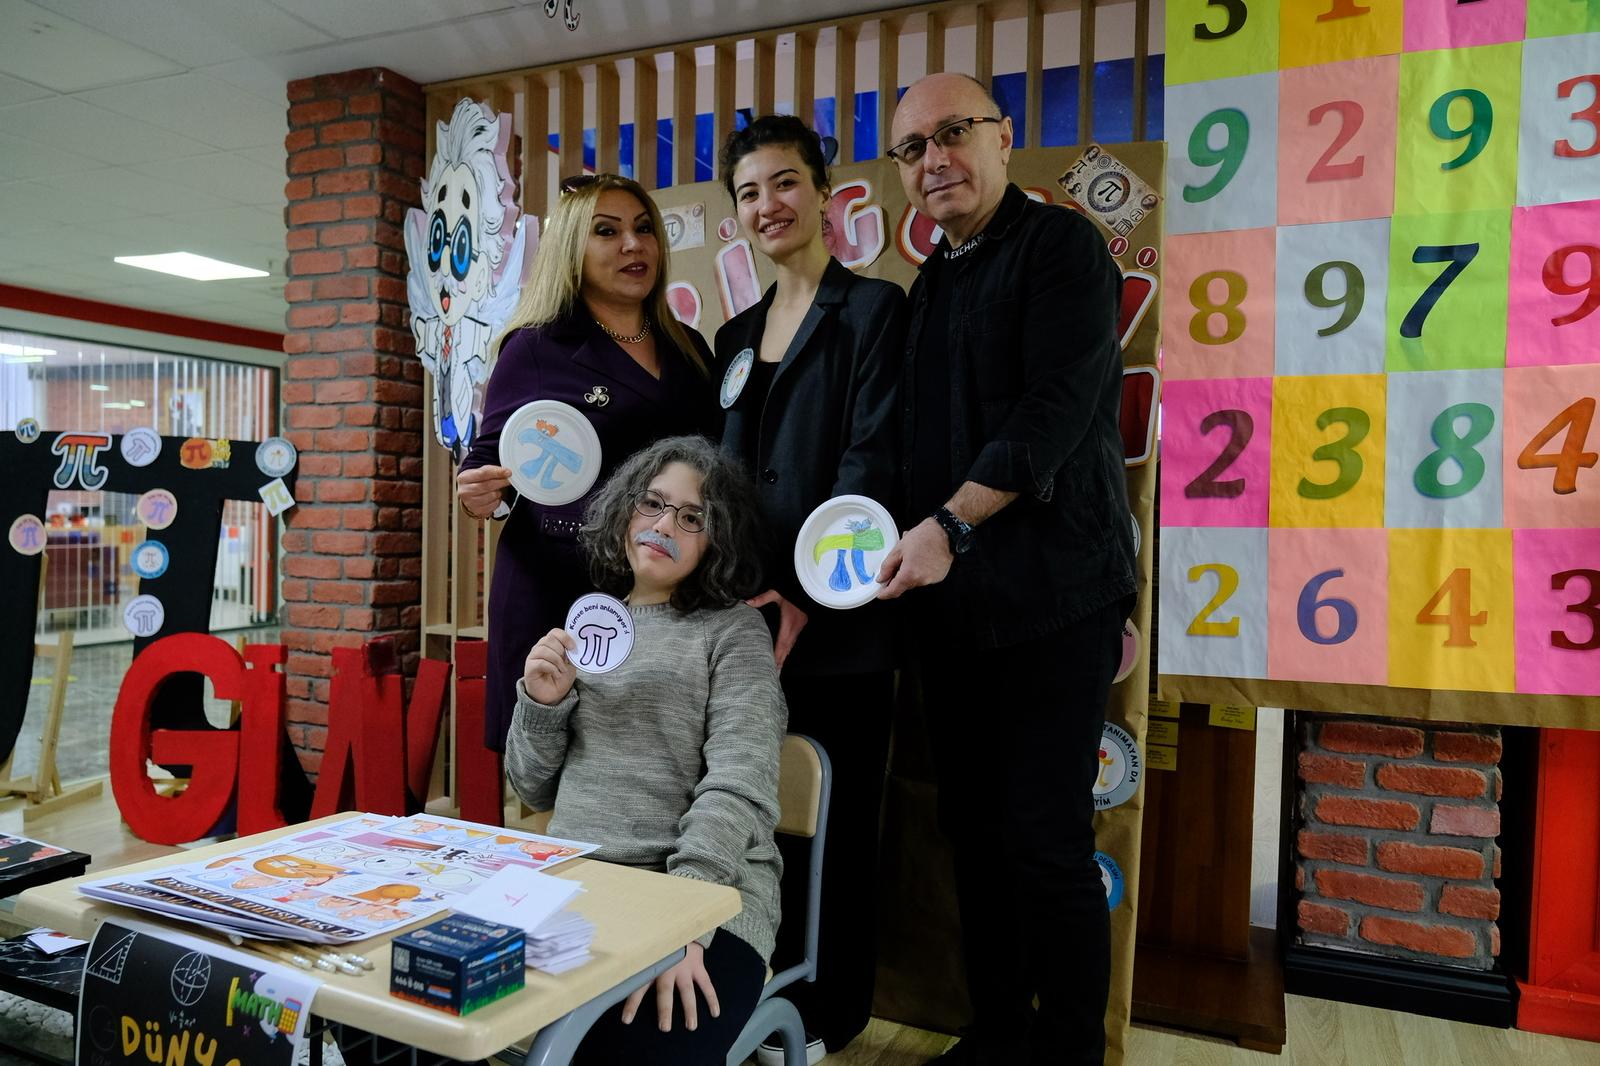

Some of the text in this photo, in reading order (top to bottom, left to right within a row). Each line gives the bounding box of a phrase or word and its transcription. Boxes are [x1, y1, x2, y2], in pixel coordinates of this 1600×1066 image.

[1182, 74, 1600, 204] 9 2 9 3
[1188, 242, 1600, 345] 8 9 7 9
[1184, 396, 1600, 500] 2 3 8 4
[584, 603, 599, 613] beni
[1186, 562, 1600, 651] 2 6 4 3
[234, 988, 284, 1025] MATH
